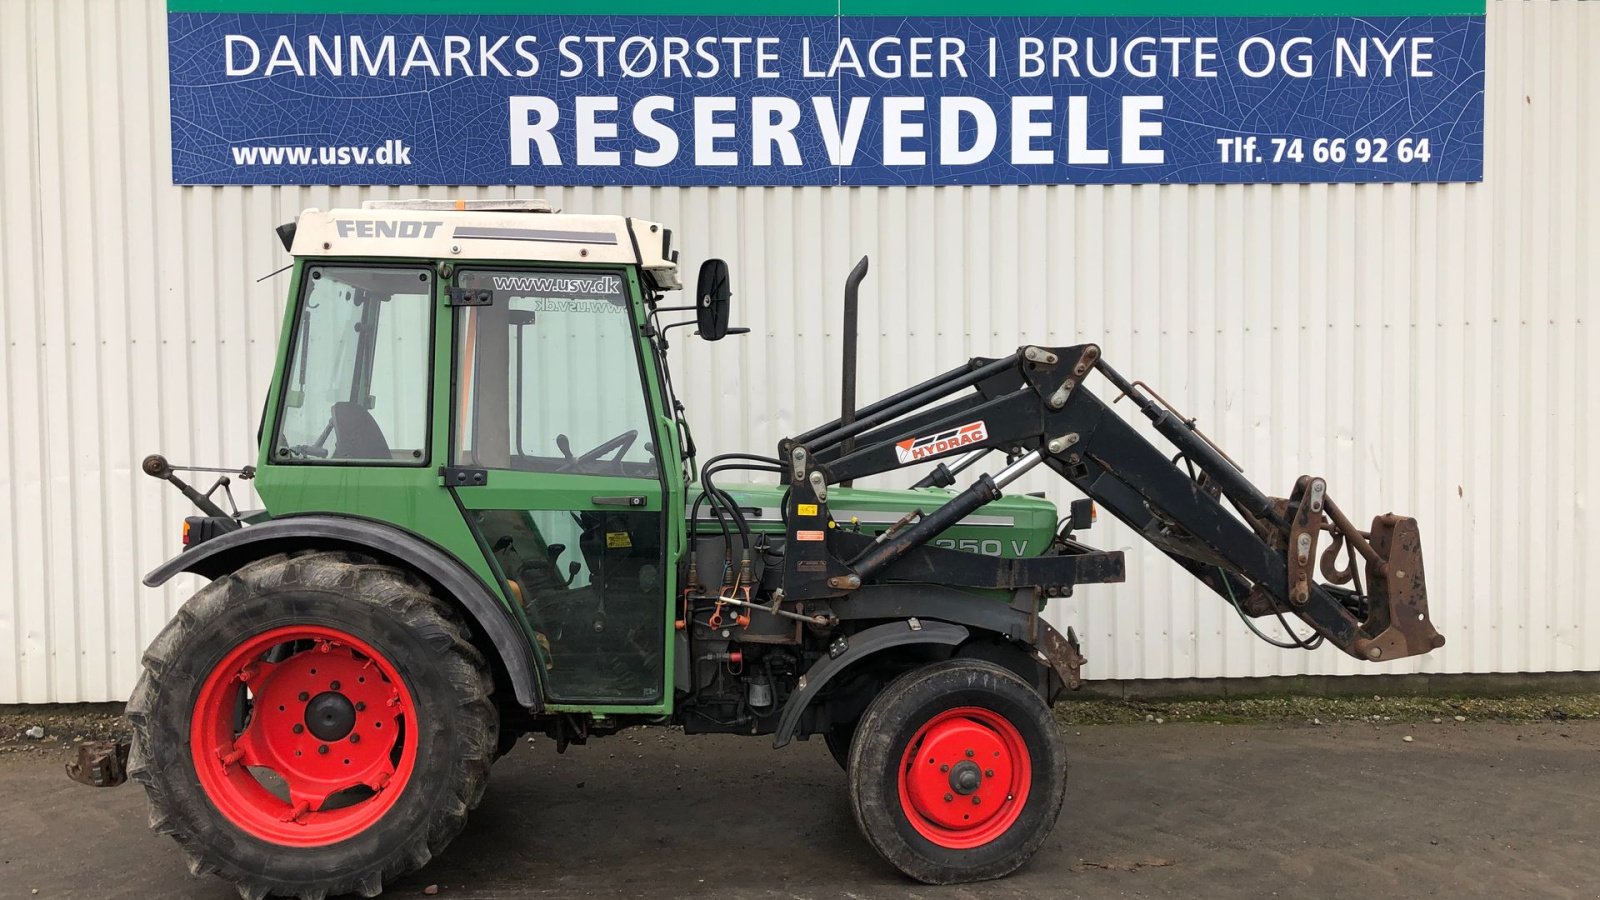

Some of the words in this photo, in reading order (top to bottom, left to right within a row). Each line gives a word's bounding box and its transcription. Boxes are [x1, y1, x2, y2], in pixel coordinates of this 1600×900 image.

[224, 34, 540, 78] DANMARKS
[558, 35, 780, 79] STØRSTE
[802, 36, 968, 79] LAGER
[988, 37, 996, 78] I
[1019, 36, 1218, 78] BRUGTE
[1238, 36, 1313, 78] OG
[1335, 37, 1434, 78] NYE
[509, 95, 1165, 167] RESERVEDELE
[231, 139, 412, 165] www.usv.dk
[1216, 136, 1264, 164] Tlf.
[1271, 138, 1304, 163] 74
[1312, 137, 1346, 163] 66
[1355, 137, 1388, 163] 92
[1397, 137, 1431, 163] 64
[336, 220, 443, 238] FENDT
[493, 277, 620, 293] www.usv.dk
[911, 430, 984, 459] HYDRAC
[1011, 540, 1028, 556] V
